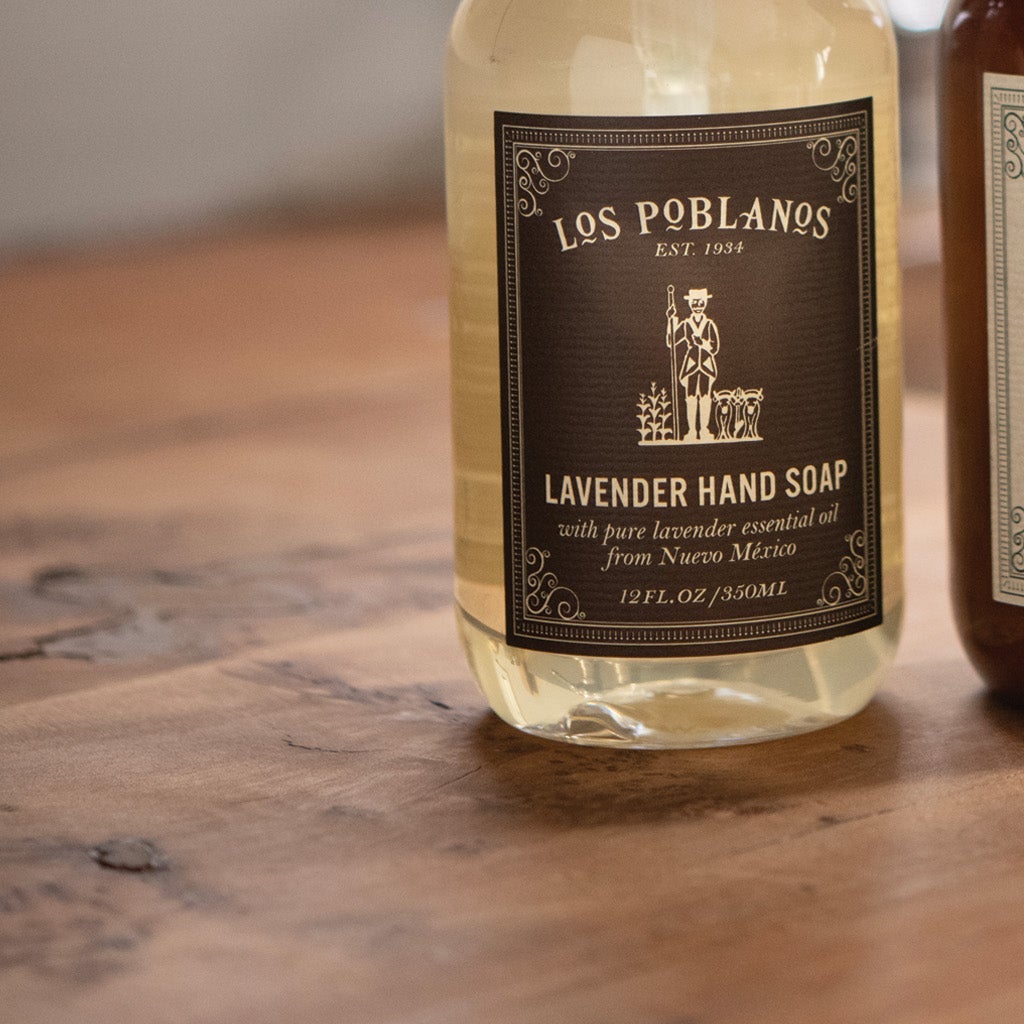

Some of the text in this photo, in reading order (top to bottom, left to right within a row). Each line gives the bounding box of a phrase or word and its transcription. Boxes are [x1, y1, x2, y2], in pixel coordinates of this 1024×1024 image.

[552, 196, 831, 251] LOS POBLANOS
[655, 241, 744, 257] EST. 1934
[545, 459, 847, 509] LAVENDER HAND SOAP
[558, 503, 839, 545] with pure lavender essential oil
[601, 539, 797, 571] from Nuevo México
